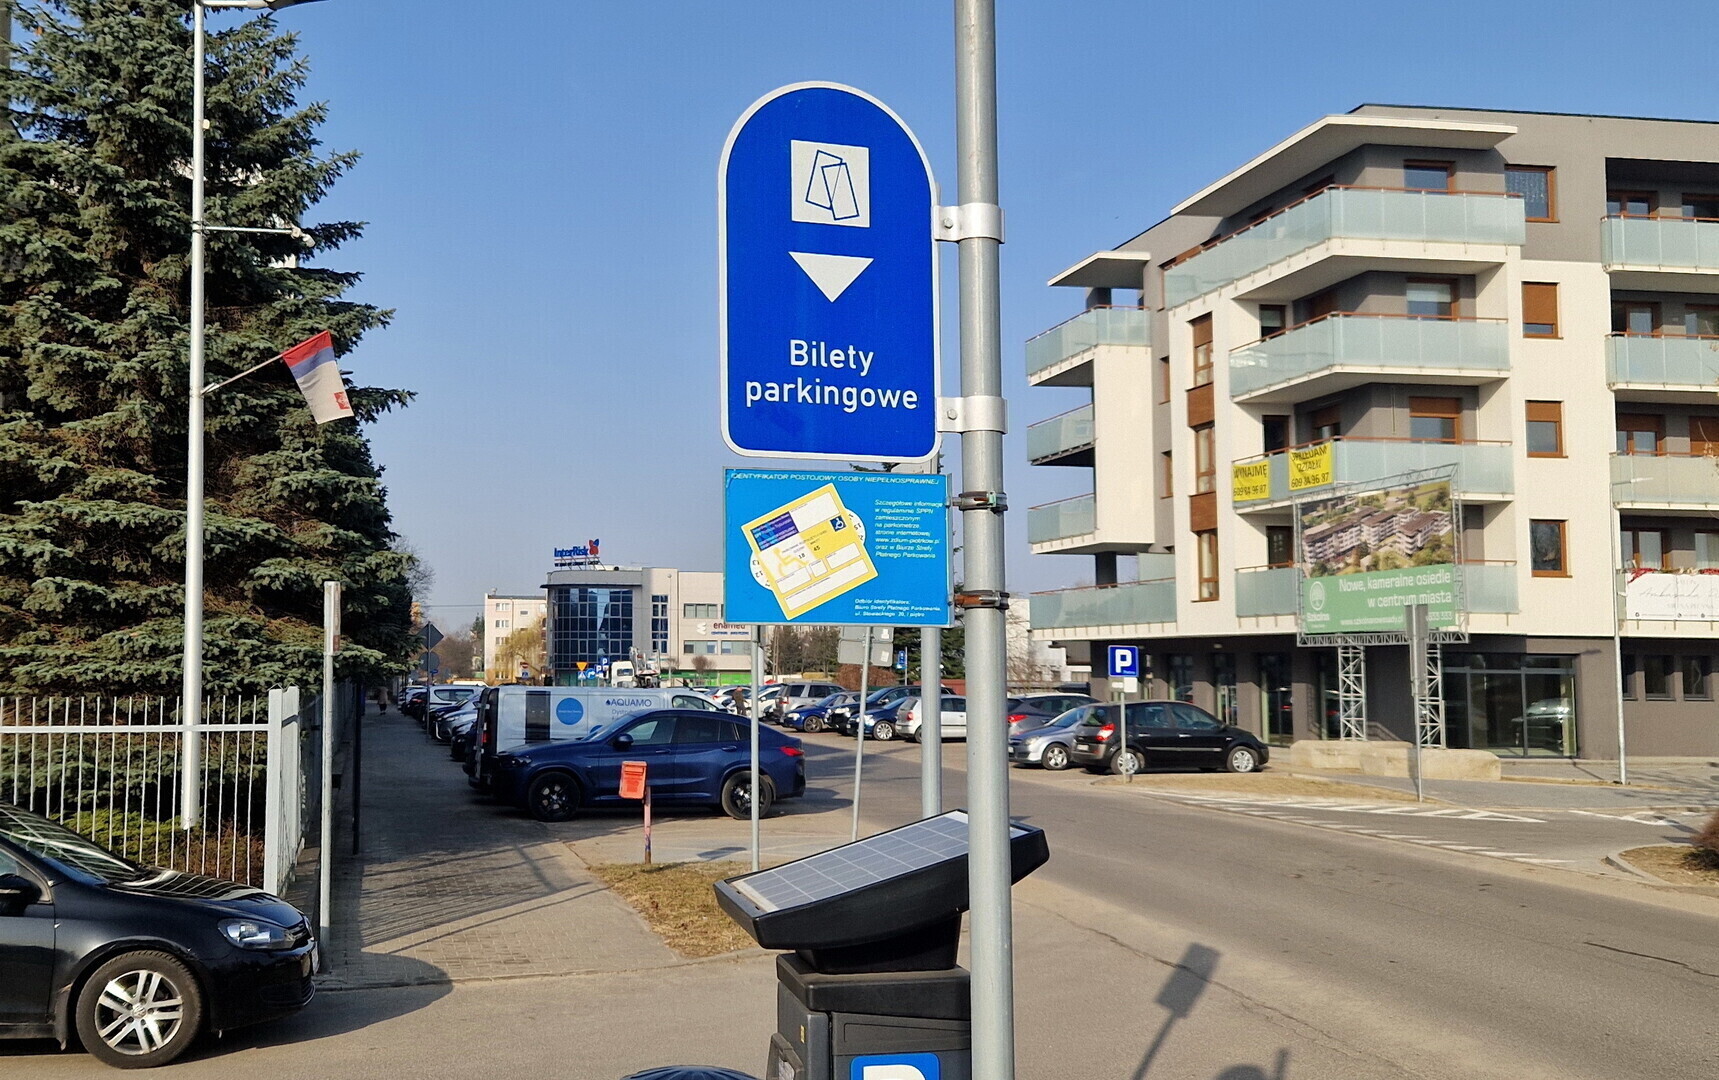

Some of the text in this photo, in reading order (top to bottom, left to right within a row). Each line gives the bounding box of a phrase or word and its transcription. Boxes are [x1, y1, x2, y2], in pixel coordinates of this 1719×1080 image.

[789, 339, 874, 377] Bilety
[746, 377, 918, 413] parkingowe
[1291, 477, 1303, 488] 609
[554, 545, 589, 557] InterRisk
[1338, 569, 1451, 592] Nowe, kameralne osiedle
[1367, 590, 1452, 608] w centrum miasta
[1115, 649, 1132, 673] P
[610, 699, 652, 707] AQUAMO
